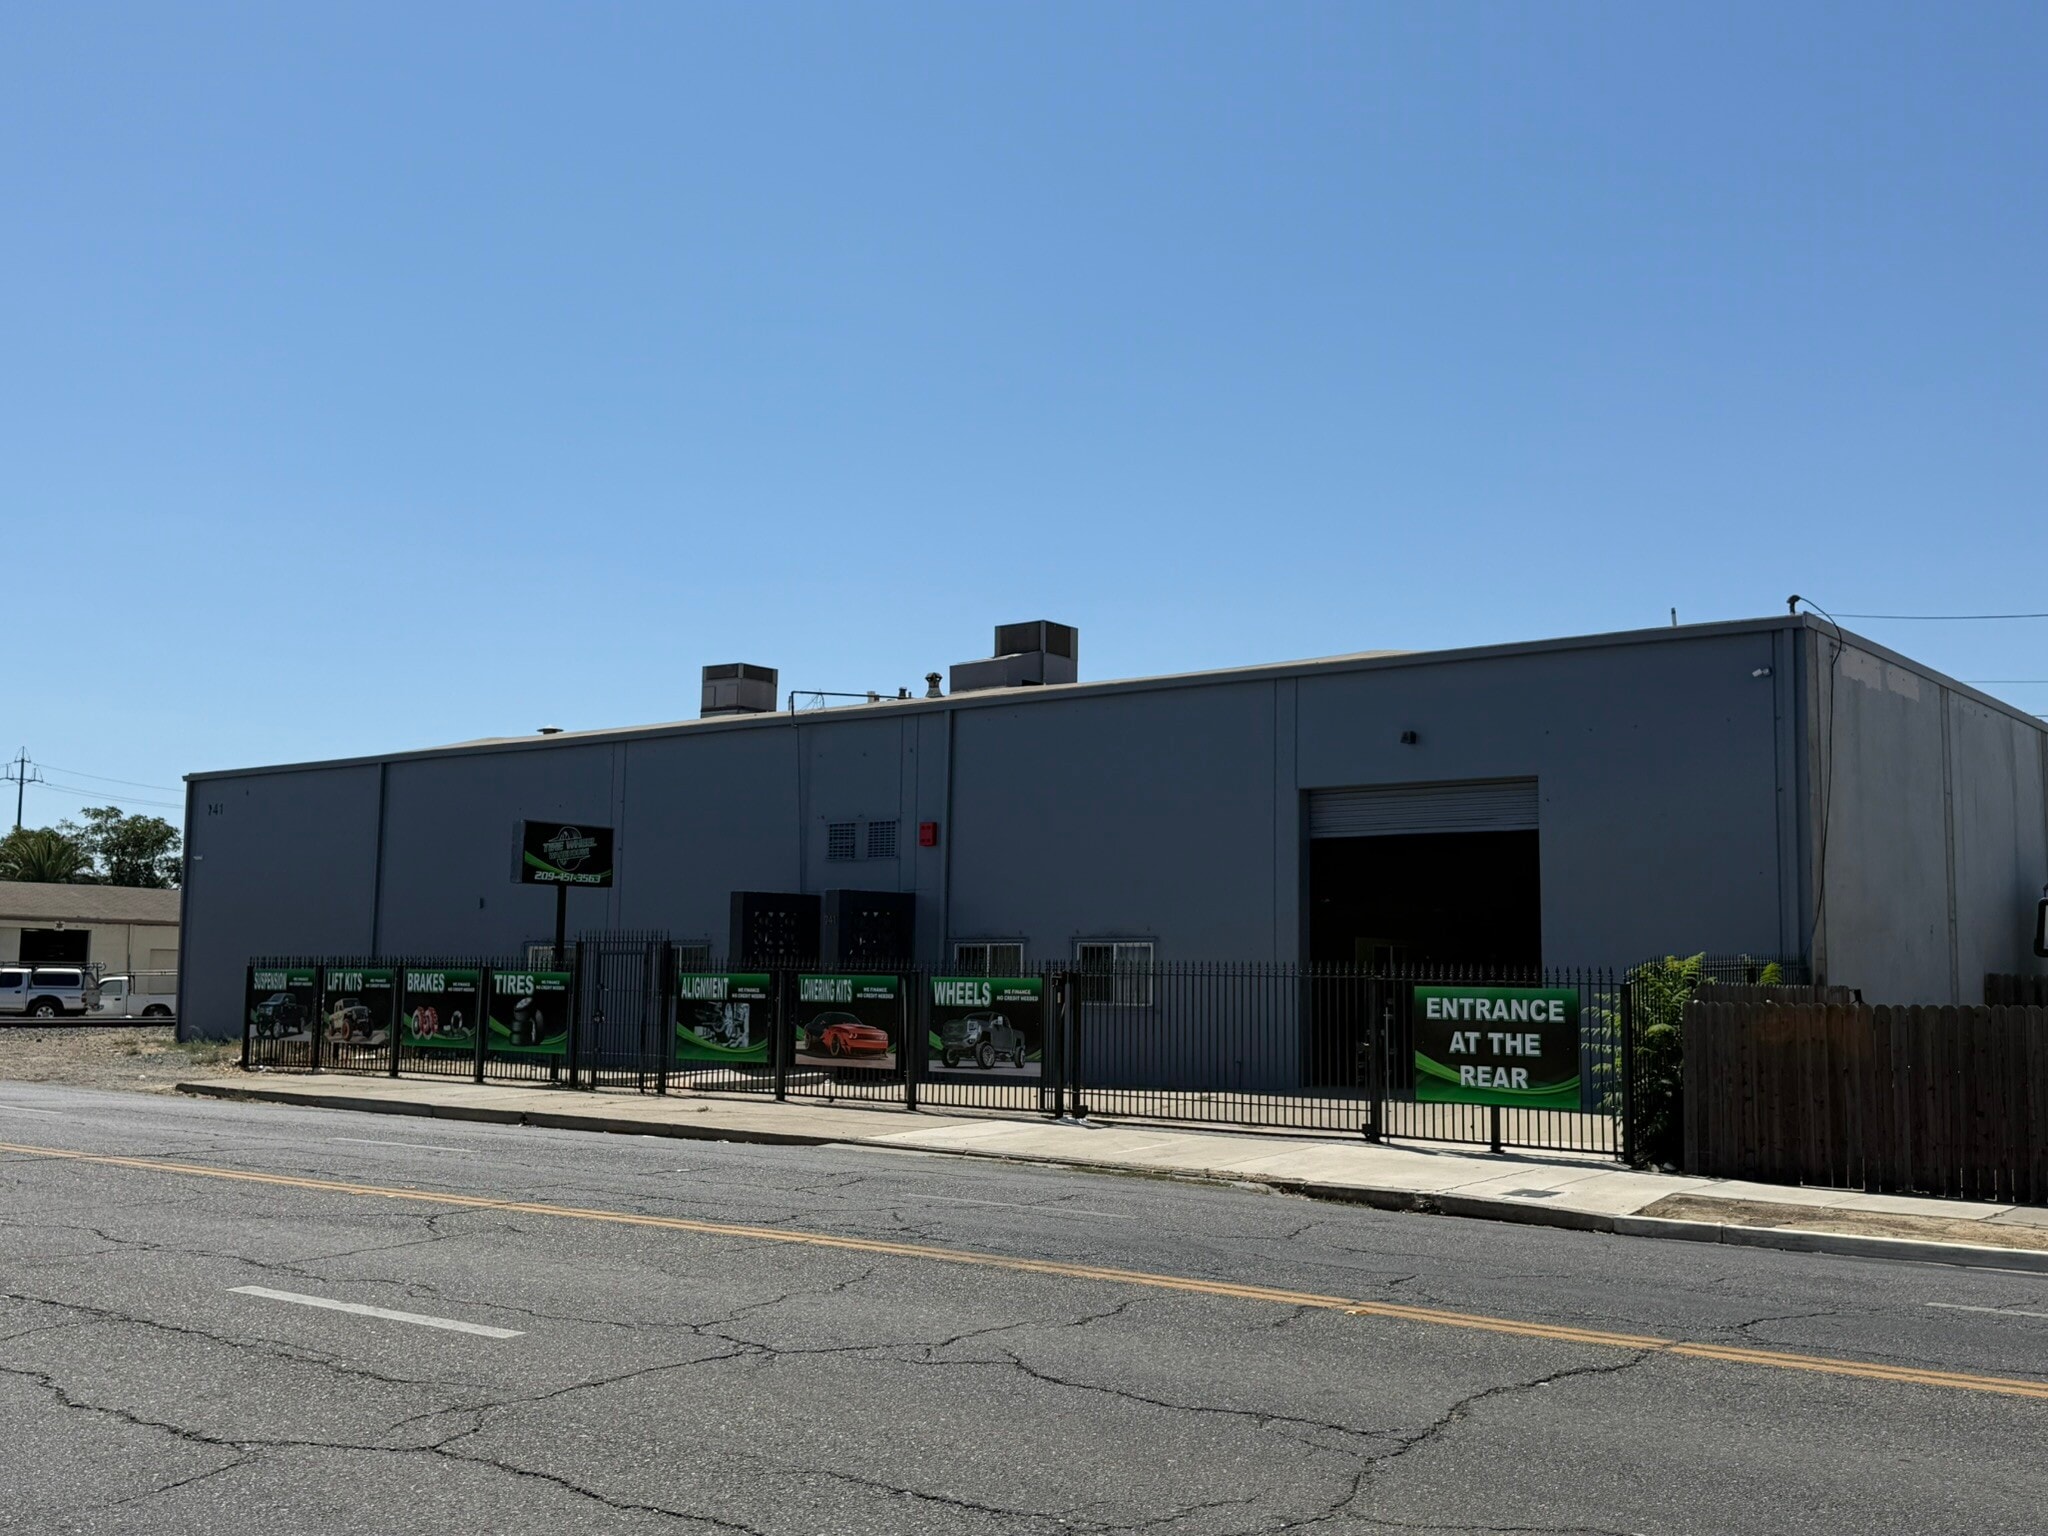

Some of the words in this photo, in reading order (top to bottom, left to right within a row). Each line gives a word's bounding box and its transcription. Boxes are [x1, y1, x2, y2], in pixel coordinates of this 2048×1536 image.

[254, 972, 287, 990] SUSPENSION
[327, 972, 344, 991] LIFT
[345, 972, 363, 992] KITS
[407, 972, 445, 993] BRAKES
[494, 974, 535, 995] TIRES
[681, 976, 729, 1000] ALIGNMENT
[800, 978, 835, 1002] LOWERING
[836, 978, 853, 1003] KITS
[934, 981, 992, 1008] WHEELS
[1426, 997, 1566, 1023] ENTRANCE
[1449, 1031, 1481, 1055] AT
[1488, 1032, 1541, 1057] THE
[1460, 1065, 1529, 1089] REAR
